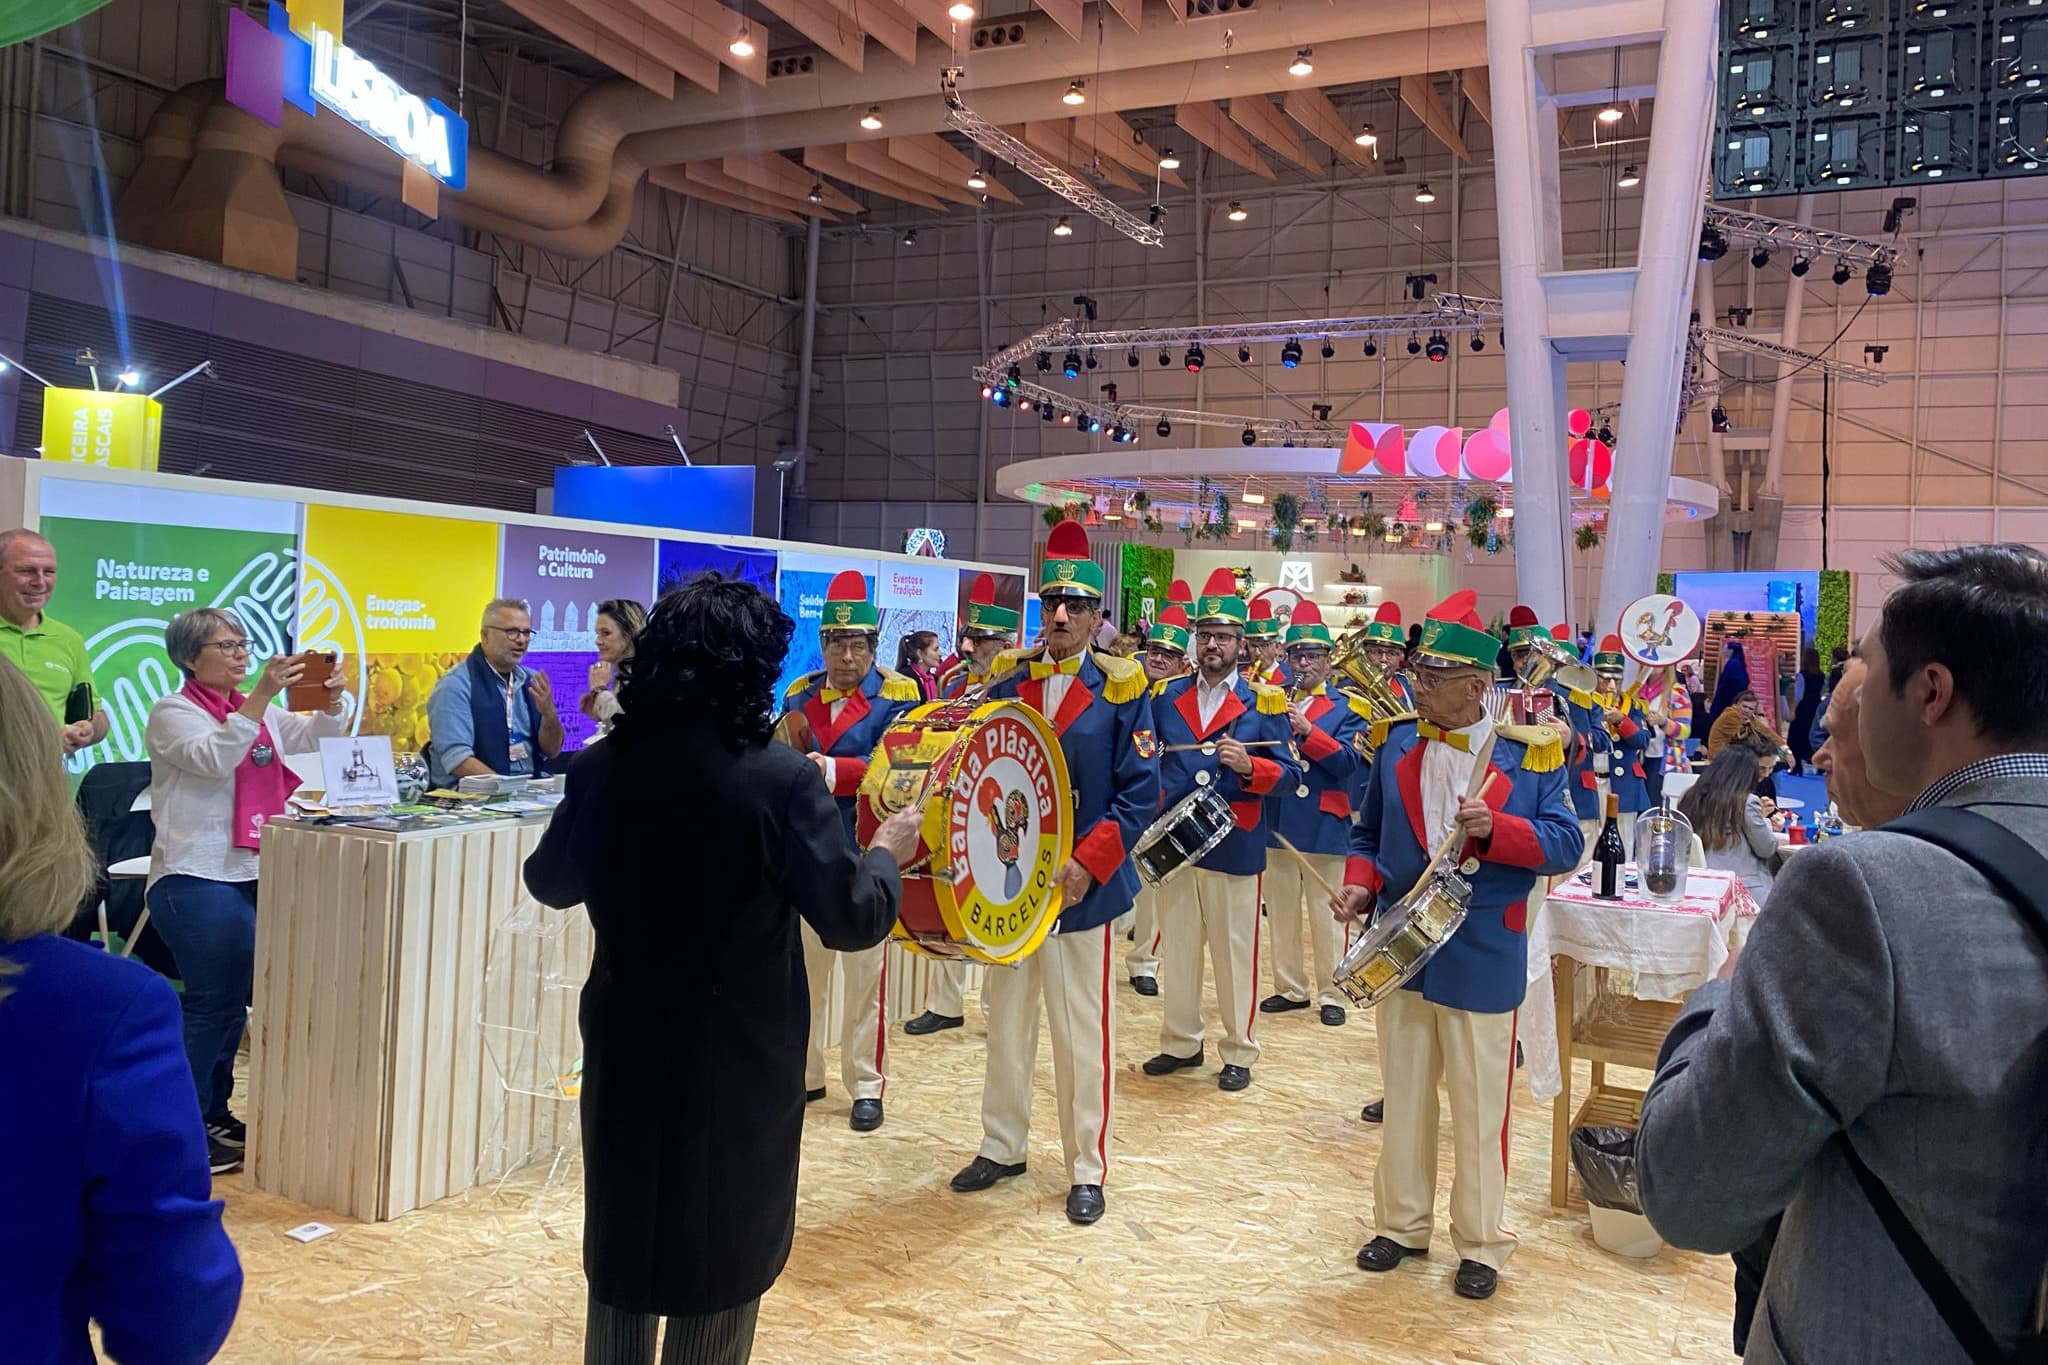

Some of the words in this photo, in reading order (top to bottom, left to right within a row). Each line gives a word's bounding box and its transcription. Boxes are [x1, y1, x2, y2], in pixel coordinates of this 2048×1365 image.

[315, 30, 452, 177] LISBOA
[539, 545, 606, 565] Património
[96, 558, 193, 582] Natureza
[197, 568, 209, 582] e
[538, 564, 547, 577] e
[548, 562, 593, 579] Cultura
[893, 572, 918, 585] Eventos
[95, 580, 195, 606] Paisagem
[799, 593, 824, 607] Saúde
[893, 584, 923, 598] Tradições
[366, 593, 426, 616] Enogas-
[366, 613, 436, 630] tronomia
[951, 751, 983, 885] Banda
[985, 724, 1052, 819] Plástica
[970, 847, 1052, 937] BARCELOS
